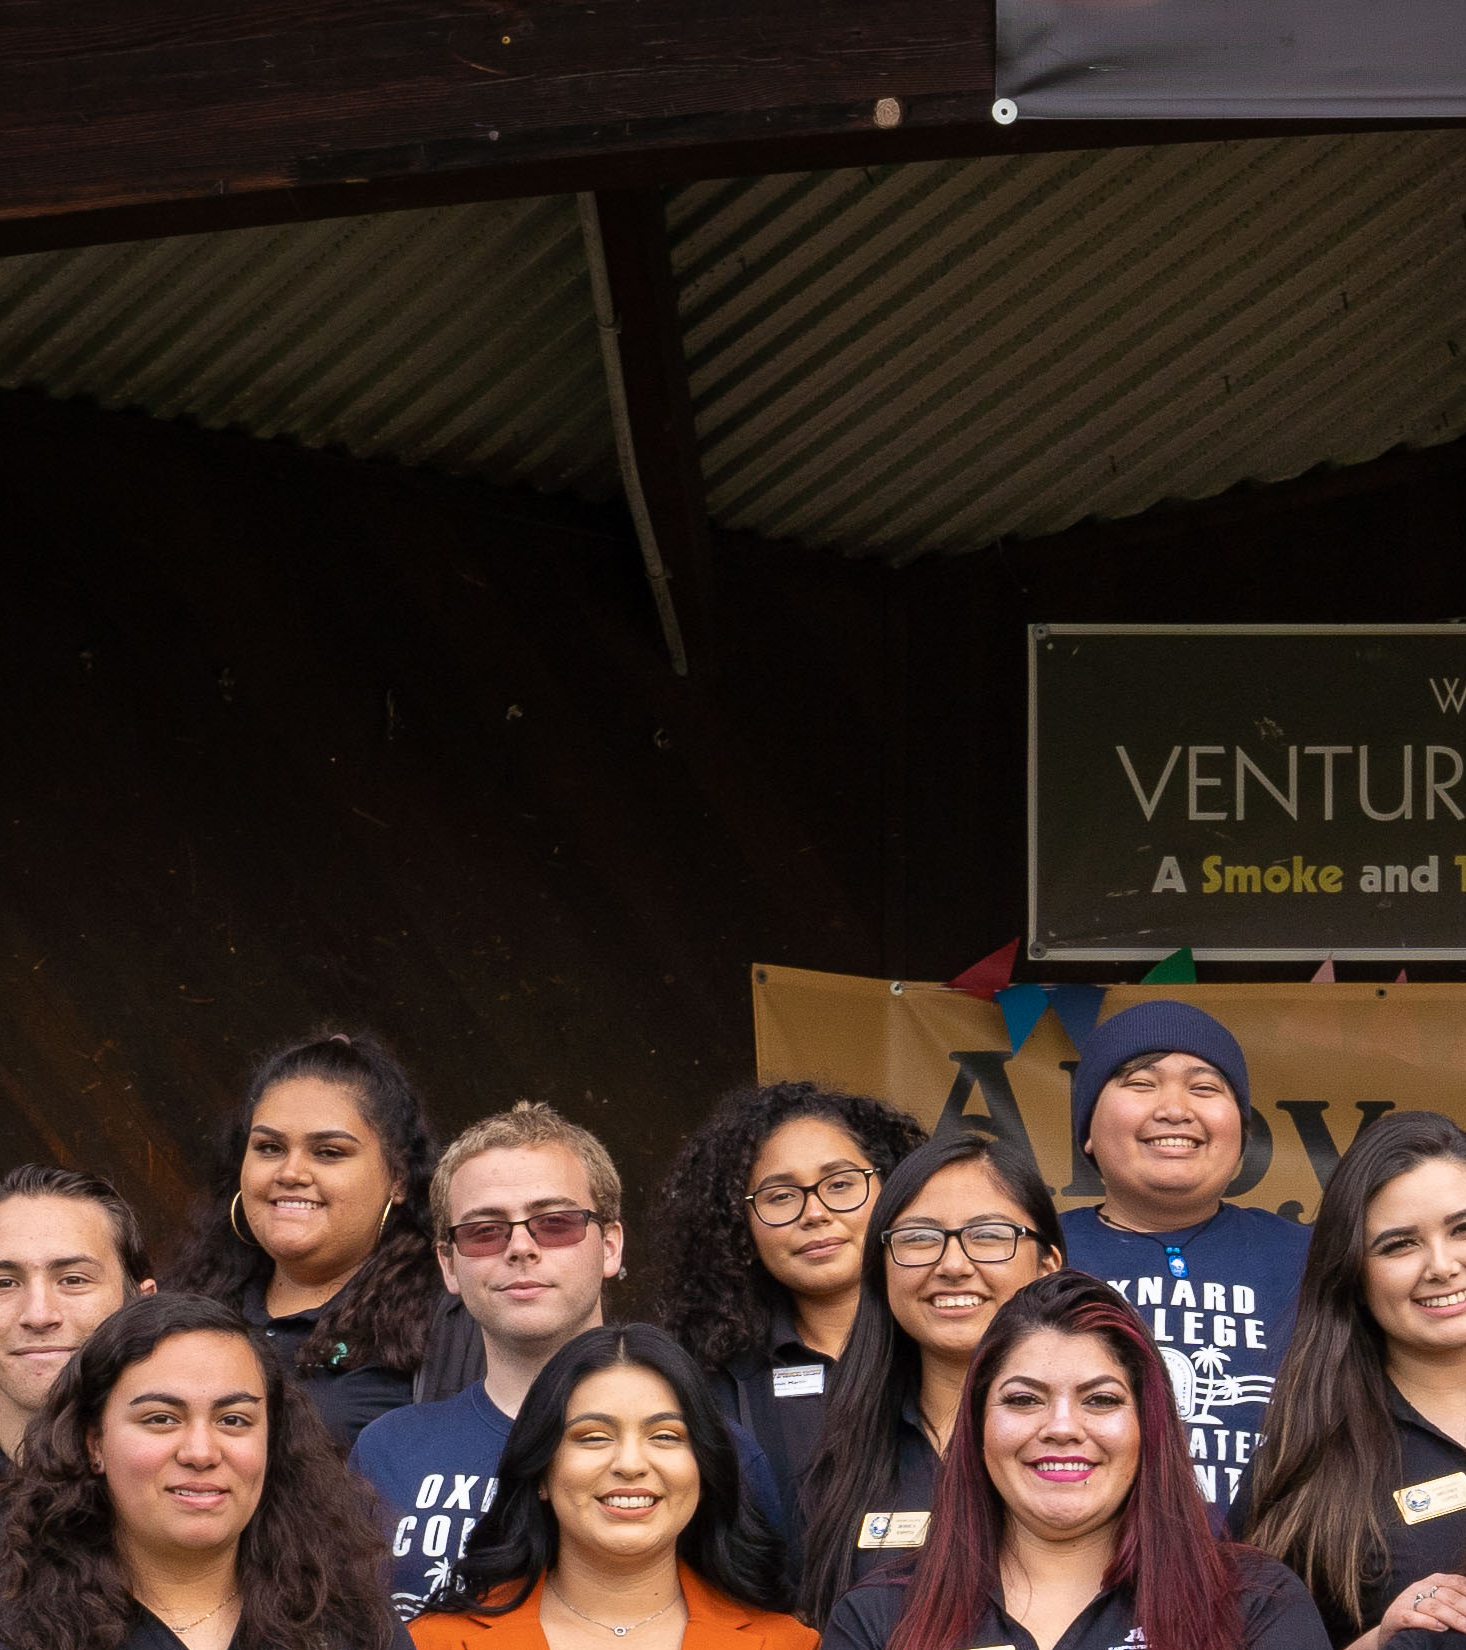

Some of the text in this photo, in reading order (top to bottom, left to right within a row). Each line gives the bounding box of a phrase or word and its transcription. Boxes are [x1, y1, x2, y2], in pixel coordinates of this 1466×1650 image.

[1151, 855, 1188, 893] A
[1201, 854, 1345, 893] Smoke
[1359, 854, 1440, 893] and
[1106, 1276, 1256, 1315] XNARD
